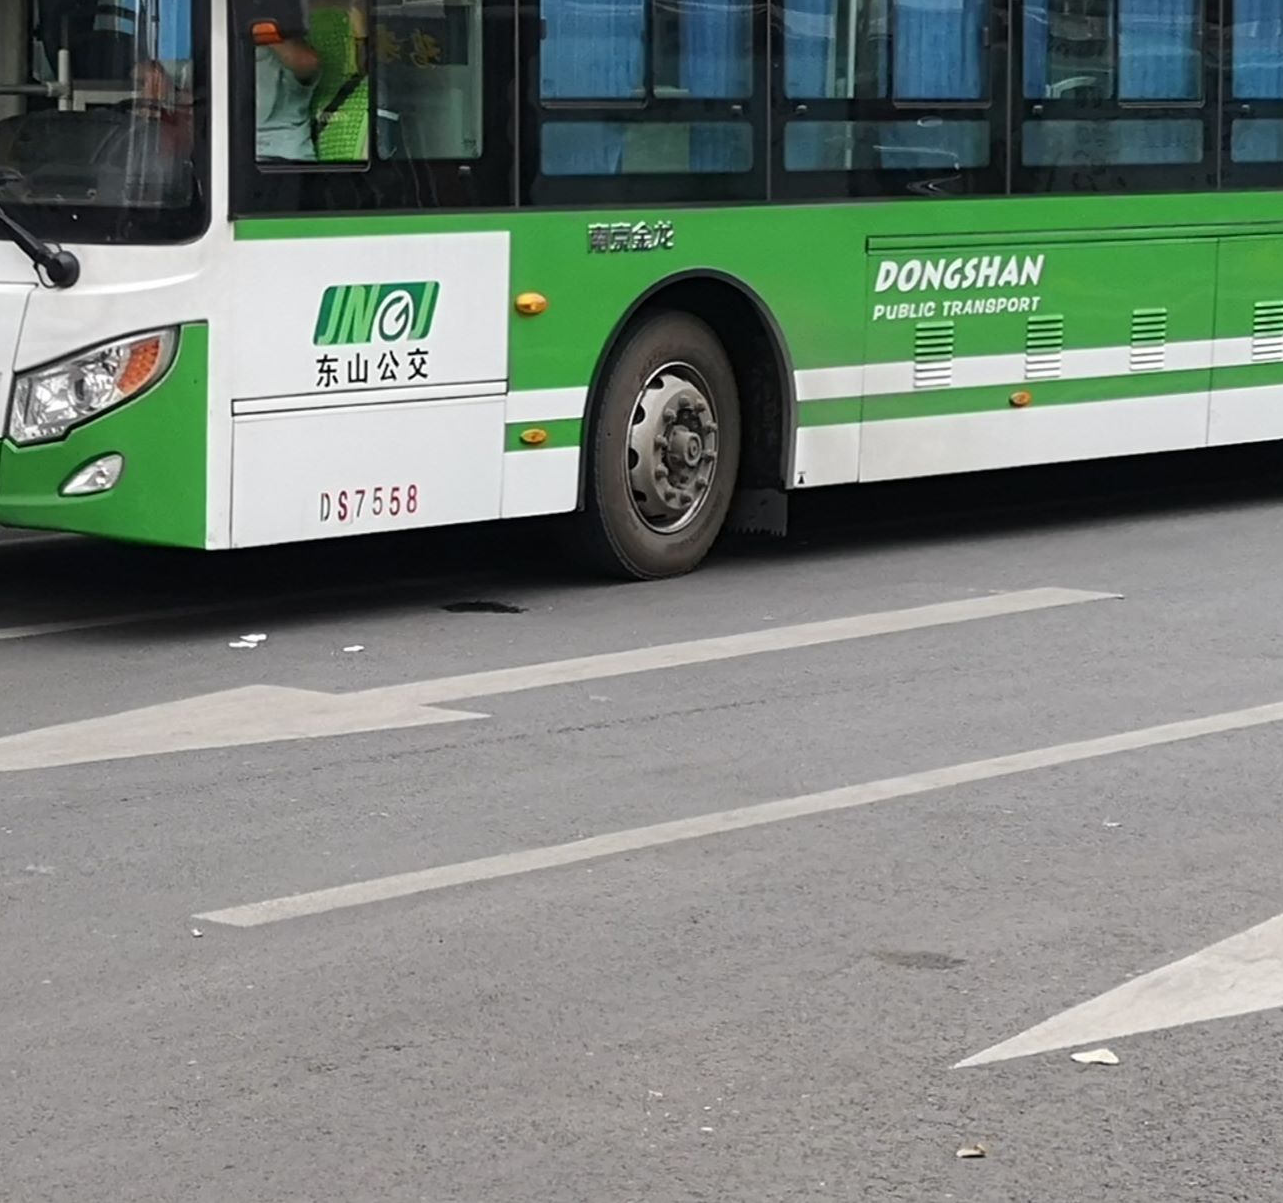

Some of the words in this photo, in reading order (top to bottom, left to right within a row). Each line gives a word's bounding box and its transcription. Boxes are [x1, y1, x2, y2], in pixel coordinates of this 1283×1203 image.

[588, 219, 675, 254] 南京金龙
[874, 253, 1045, 293] DONGSHAN
[872, 301, 936, 321] PUBLIC
[942, 296, 1041, 317] TRANSPORT
[316, 348, 429, 388] 东山公交
[319, 484, 419, 522] DS7558
